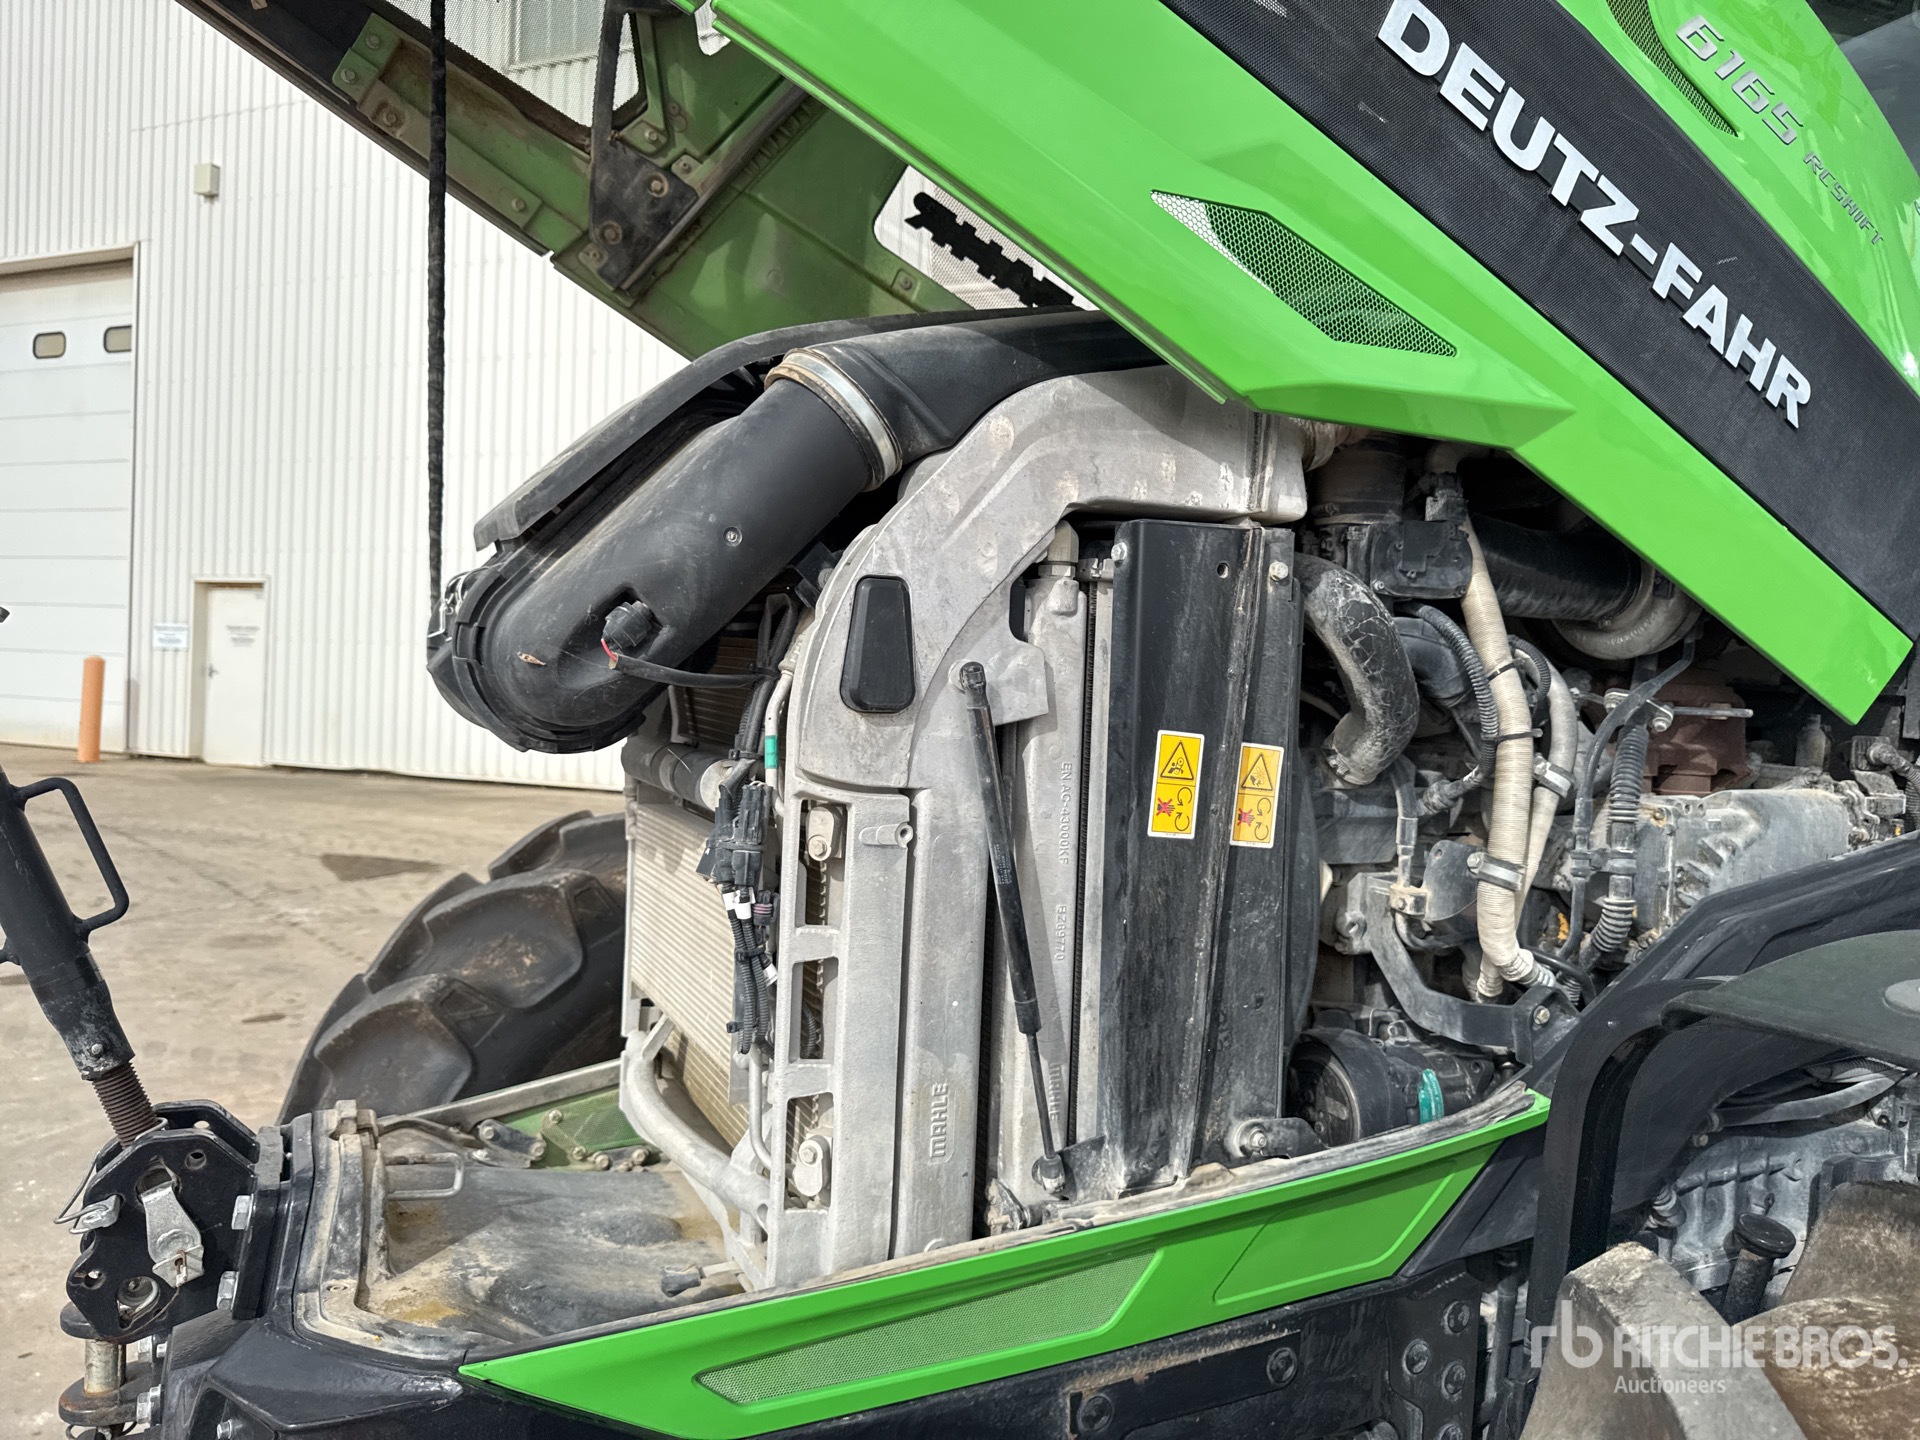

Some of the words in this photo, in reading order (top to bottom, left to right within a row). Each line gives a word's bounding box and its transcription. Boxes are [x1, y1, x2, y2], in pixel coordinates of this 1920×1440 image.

[1675, 15, 1805, 146] 6165
[1377, 0, 1811, 428] DEUTZ-FAHR
[1060, 761, 1073, 781] EN
[929, 1082, 949, 1158] MAHLE
[1048, 1063, 1064, 1121] MAHLE
